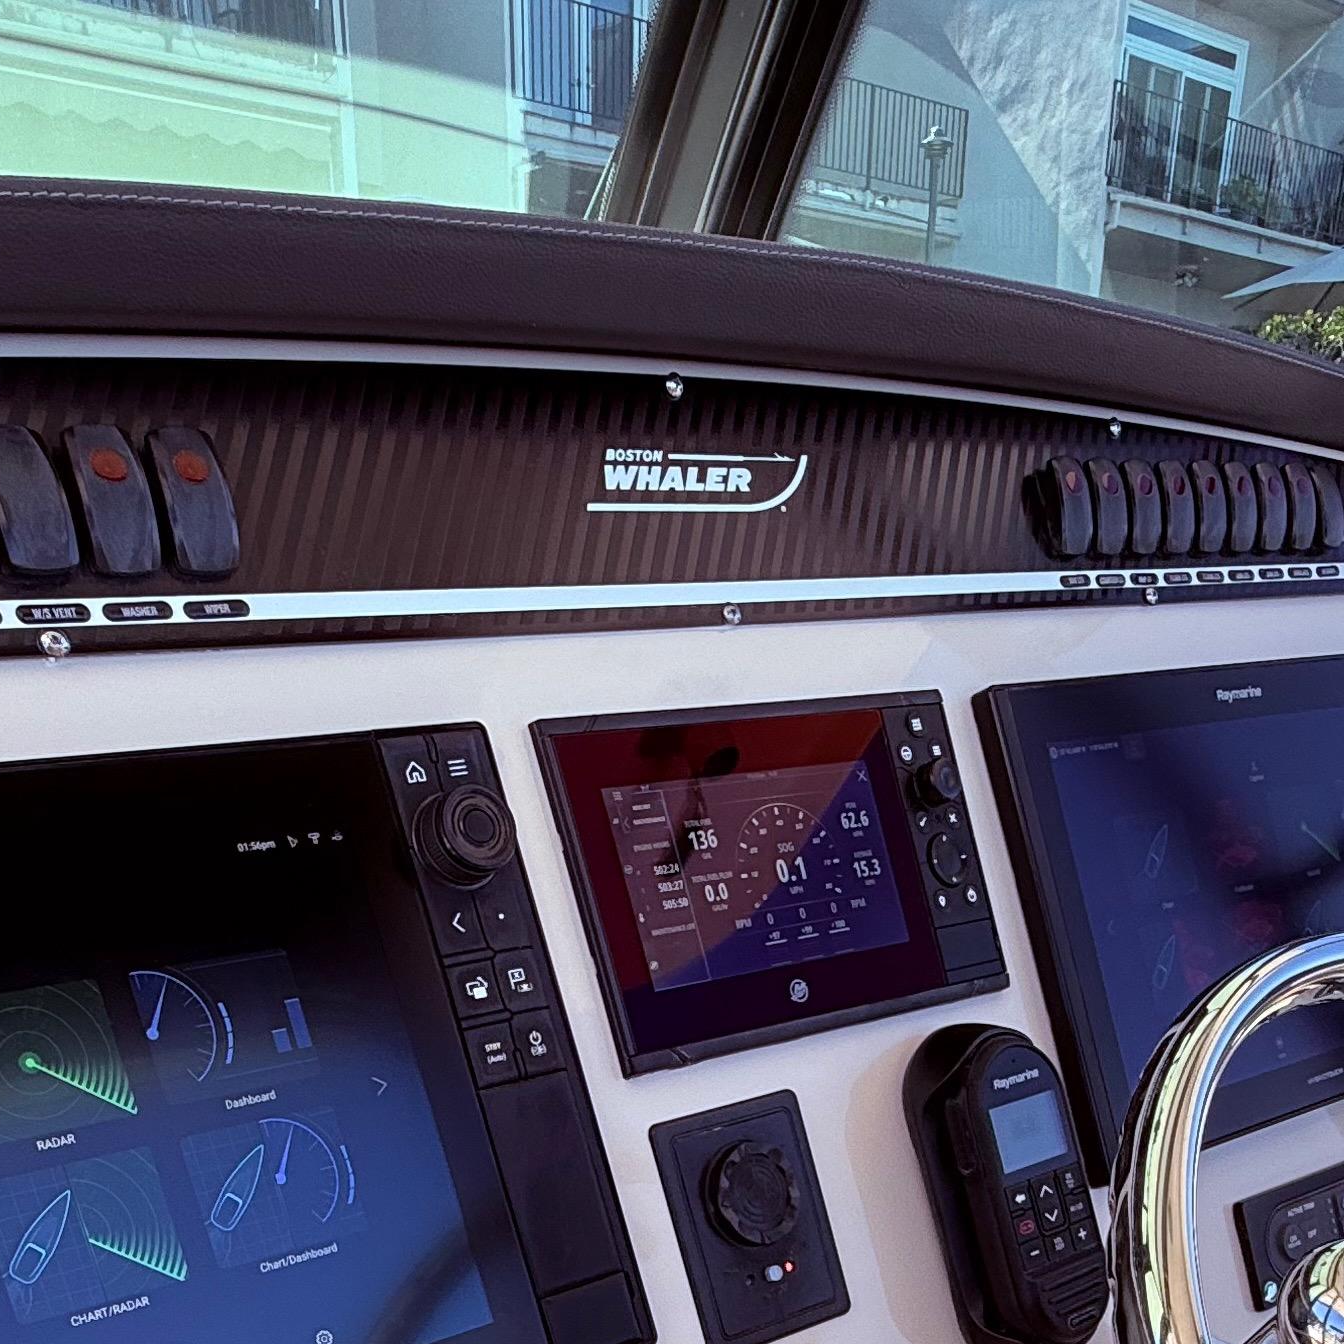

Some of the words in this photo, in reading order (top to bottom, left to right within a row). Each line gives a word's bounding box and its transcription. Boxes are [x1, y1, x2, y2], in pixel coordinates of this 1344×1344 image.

[605, 448, 664, 463] BOSTON
[603, 464, 752, 492] WHALER
[31, 607, 52, 620] W/S
[53, 606, 78, 619] VENT
[120, 605, 159, 617] WASHER
[1216, 685, 1263, 703] Raymarine
[841, 810, 870, 829] 62.6
[688, 829, 718, 851] 136
[777, 842, 795, 853] SOG
[775, 856, 808, 883] 0.1
[853, 859, 882, 878] 15.3
[704, 883, 728, 902] 0.0
[766, 913, 774, 925] 0
[799, 907, 806, 919] 0
[830, 901, 837, 914] 0
[993, 1068, 1039, 1090] Raymarine
[224, 1089, 277, 1110] Dashboard
[36, 1133, 77, 1151] RADAR
[259, 1242, 339, 1273] Chart/Dashboard
[70, 1296, 150, 1327] CHART/RADAR
